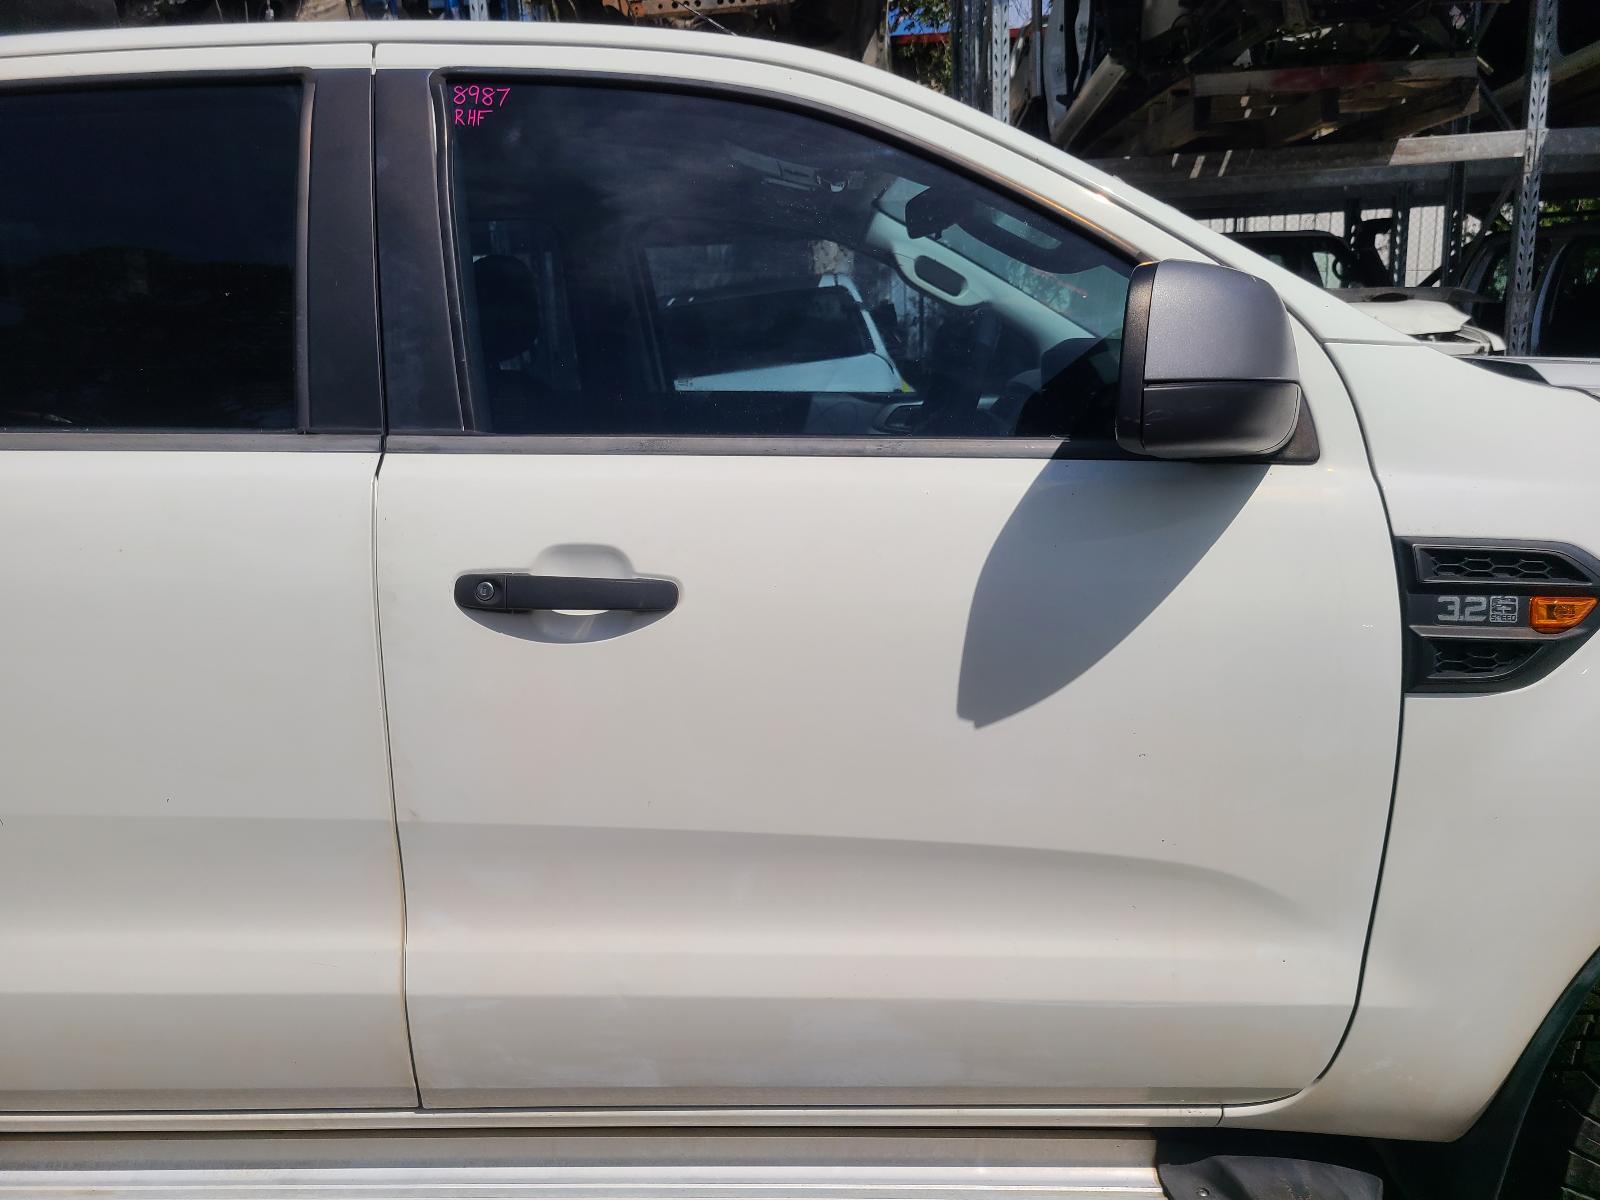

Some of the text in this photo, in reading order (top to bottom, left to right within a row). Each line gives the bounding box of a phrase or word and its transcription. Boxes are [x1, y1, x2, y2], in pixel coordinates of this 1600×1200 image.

[453, 85, 511, 107] 8987
[454, 109, 493, 127] RHF
[1438, 596, 1487, 622] 3.2
